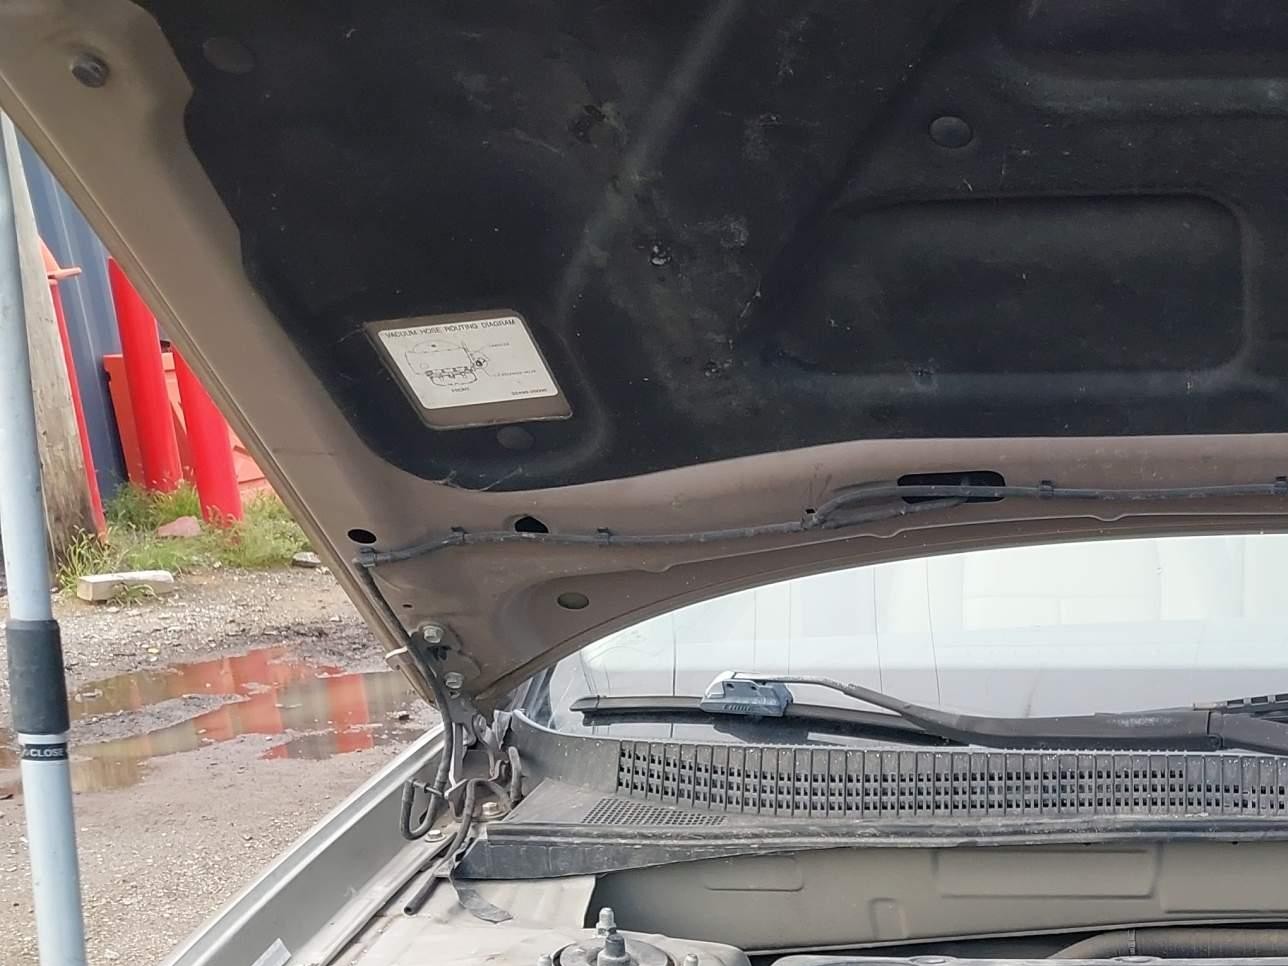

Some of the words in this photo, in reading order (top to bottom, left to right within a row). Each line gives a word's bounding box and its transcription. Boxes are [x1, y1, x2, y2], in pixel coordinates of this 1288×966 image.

[384, 330, 418, 339] VACUUM
[420, 327, 440, 335] HOSE
[444, 323, 479, 333] ROUTING
[481, 319, 516, 328] DIAGRAM
